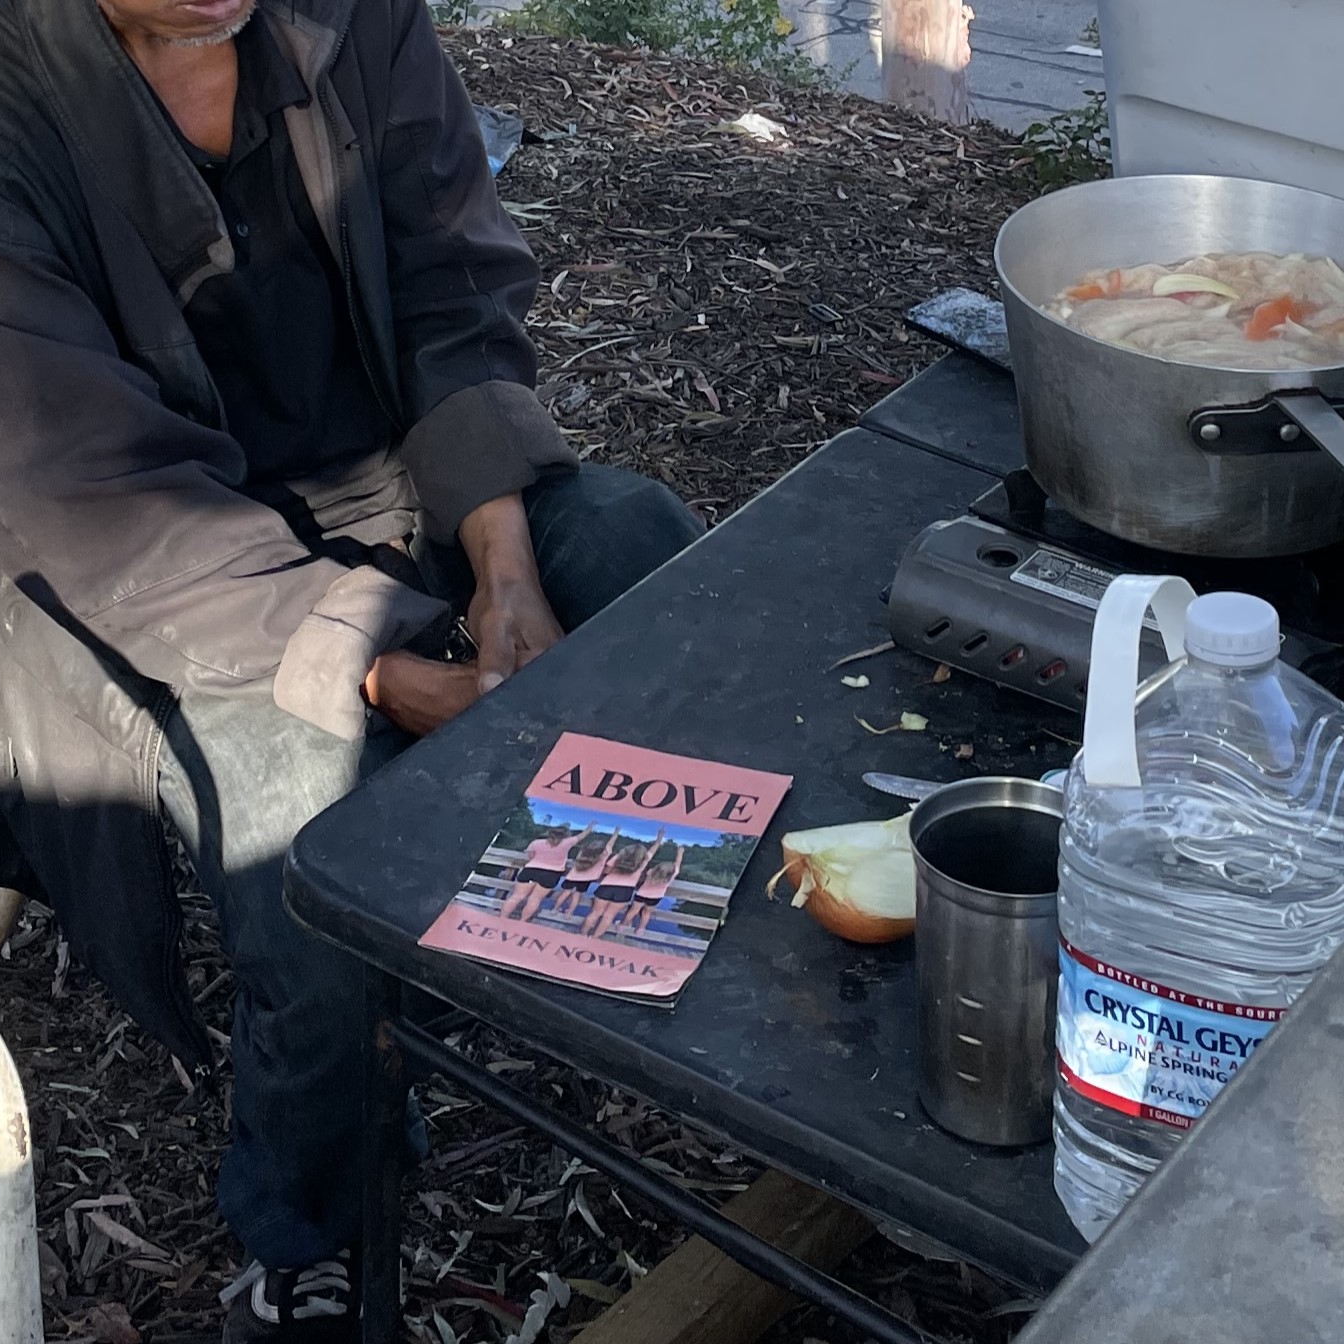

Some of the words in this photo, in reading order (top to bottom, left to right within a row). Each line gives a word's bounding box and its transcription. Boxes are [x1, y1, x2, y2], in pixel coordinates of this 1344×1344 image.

[543, 763, 759, 824] ABOVE
[456, 919, 551, 952] KEVIN
[555, 944, 664, 979] NOWAK
[1097, 963, 1159, 994] BOTTLED
[1168, 990, 1186, 1003] AT
[1196, 998, 1225, 1013] THE
[1084, 988, 1190, 1045] CRYSTAL
[1094, 1029, 1158, 1066] ALPINE
[1160, 1055, 1228, 1084] SPRING
[1148, 1109, 1154, 1118] 1
[1155, 1110, 1189, 1128] GALLON
[1150, 1085, 1165, 1096] BY
[1167, 1089, 1185, 1102] CG
